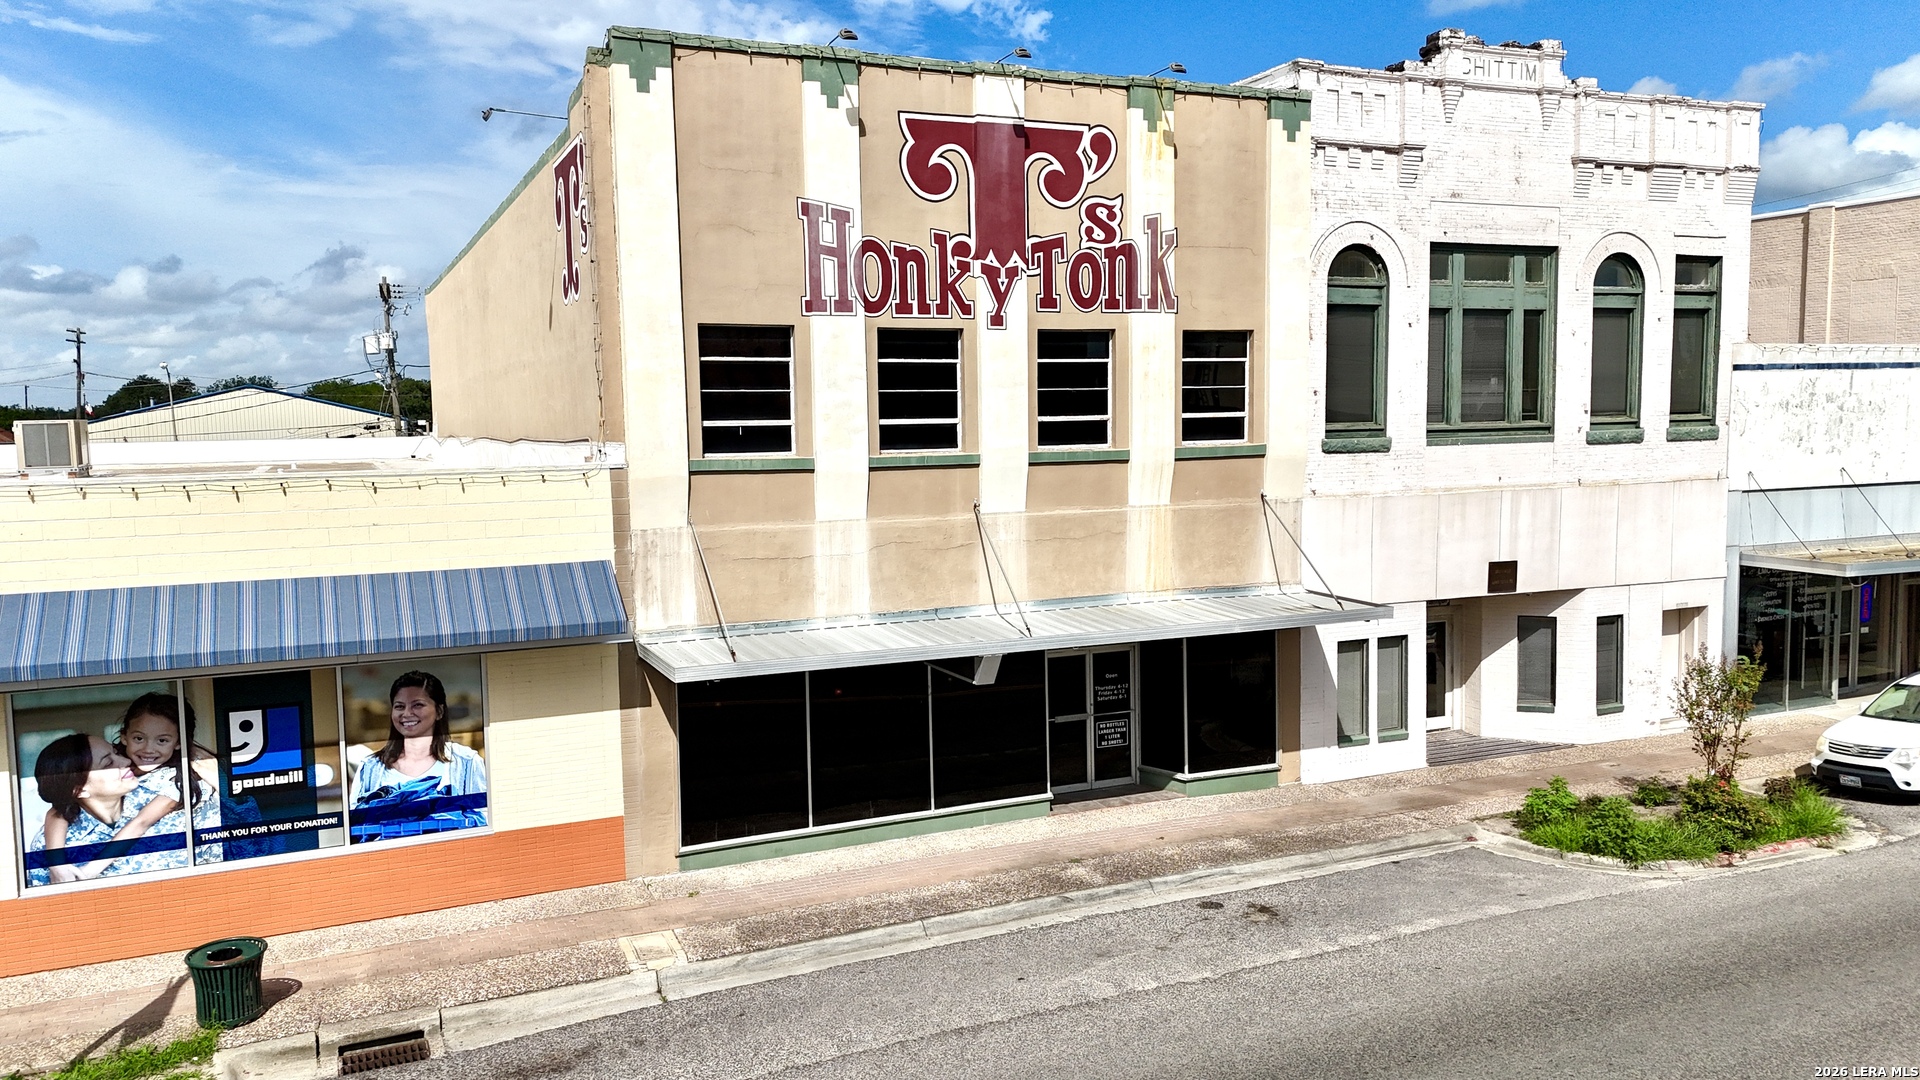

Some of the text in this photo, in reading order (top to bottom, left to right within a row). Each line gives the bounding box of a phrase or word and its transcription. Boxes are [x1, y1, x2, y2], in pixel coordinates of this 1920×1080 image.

[1462, 57, 1537, 82] CHITTIM
[232, 770, 303, 795] goodwill
[200, 817, 338, 841] THANK YOU FOR YOUR DONATION!
